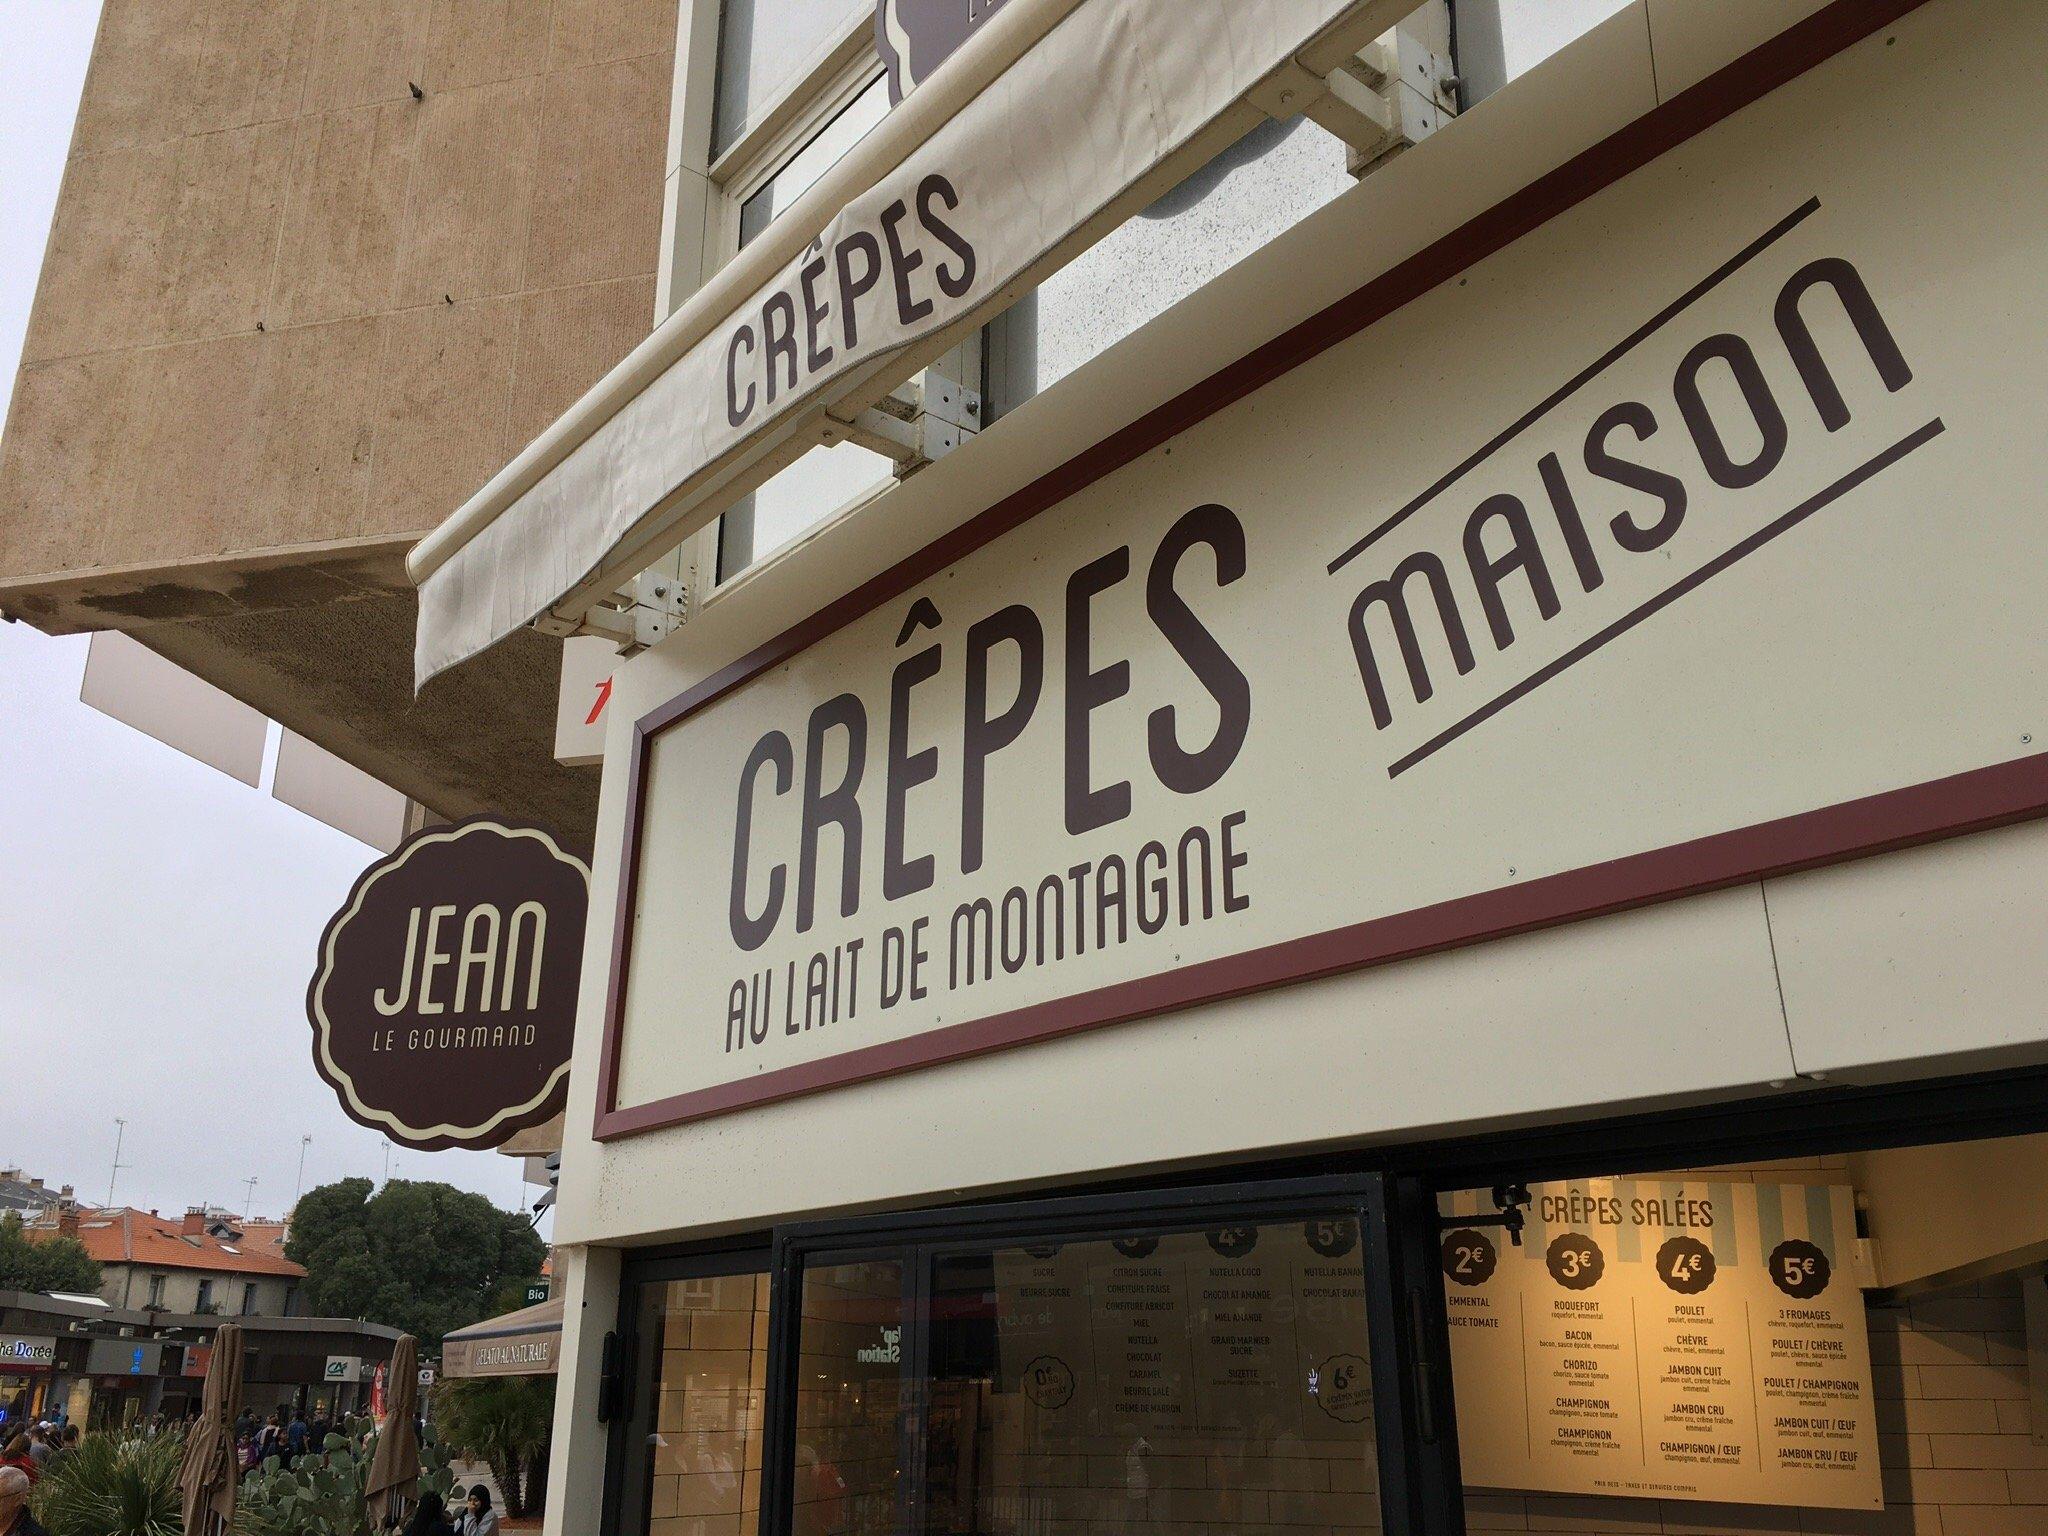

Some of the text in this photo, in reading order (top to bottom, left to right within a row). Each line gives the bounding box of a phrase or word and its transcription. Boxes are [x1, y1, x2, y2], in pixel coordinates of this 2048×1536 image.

[727, 174, 976, 427] CRÊPES
[1347, 257, 1914, 731] MAISON
[729, 504, 1250, 951] CRÊPES
[726, 810, 1250, 1054] AU LAIT DE MONTAGNE
[374, 901, 546, 1016] JEAN
[373, 1024, 536, 1052] LE GOURMAND
[1541, 1189, 1713, 1227] CRÊPES SALÉES
[1455, 1247, 1483, 1273] 2€
[1562, 1250, 1591, 1277] 3€
[1672, 1254, 1702, 1282] 4€
[1784, 1257, 1815, 1285] 5€
[528, 1289, 544, 1300] Bio
[1449, 1296, 1490, 1307] EMMENTAL
[1554, 1301, 1599, 1311] ROQUEFORT
[1675, 1305, 1705, 1315] POULET
[1779, 1310, 1831, 1320] 3 FROMAGES
[1469, 1317, 1499, 1328] TOMATE
[1565, 1331, 1592, 1340] BACON
[1677, 1333, 1708, 1346] CHÈVRE
[16, 1342, 52, 1357] Dorée
[1772, 1339, 1803, 1349] POULET
[1811, 1339, 1843, 1351] CHÈVRE
[1563, 1359, 1598, 1370] CHORIZO
[1668, 1365, 1722, 1376] JAMBON CUIT
[1764, 1378, 1795, 1388] POULET
[1803, 1379, 1859, 1390] CHAMPIGNON
[1556, 1397, 1610, 1409] CHAMPIGNON
[1672, 1404, 1724, 1415] JAMBON CRU
[1774, 1417, 1809, 1428] JAMBON
[1811, 1419, 1829, 1429] CUIT
[1558, 1428, 1612, 1440] CHAMPIGNON
[1660, 1442, 1715, 1454] CHAMPIGNON
[1778, 1448, 1812, 1459] JAMBON
[1815, 1450, 1832, 1460] CRU
